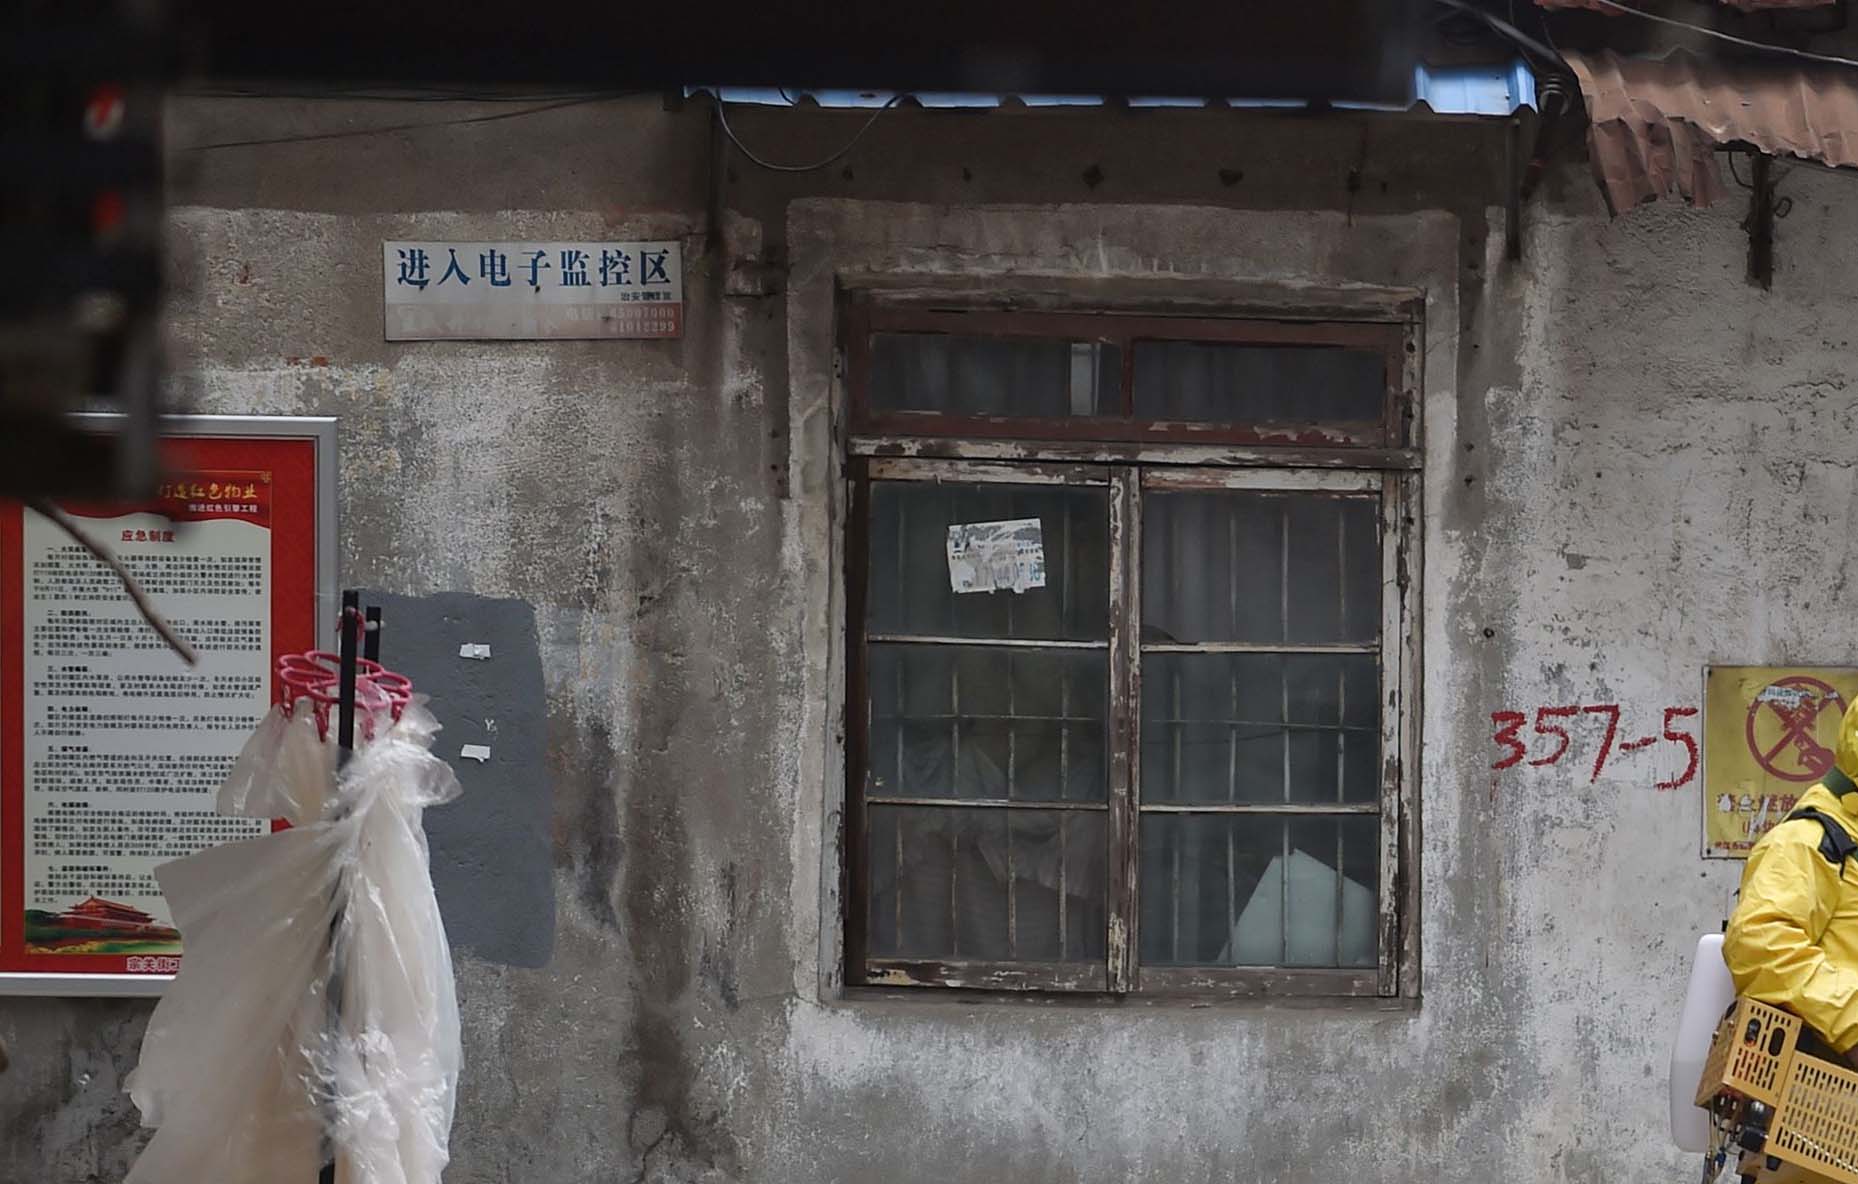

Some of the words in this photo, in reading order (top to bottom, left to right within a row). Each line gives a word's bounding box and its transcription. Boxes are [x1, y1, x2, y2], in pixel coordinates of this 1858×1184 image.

[397, 249, 672, 287] 进入电子监控区
[1491, 704, 1699, 791] 357-5
